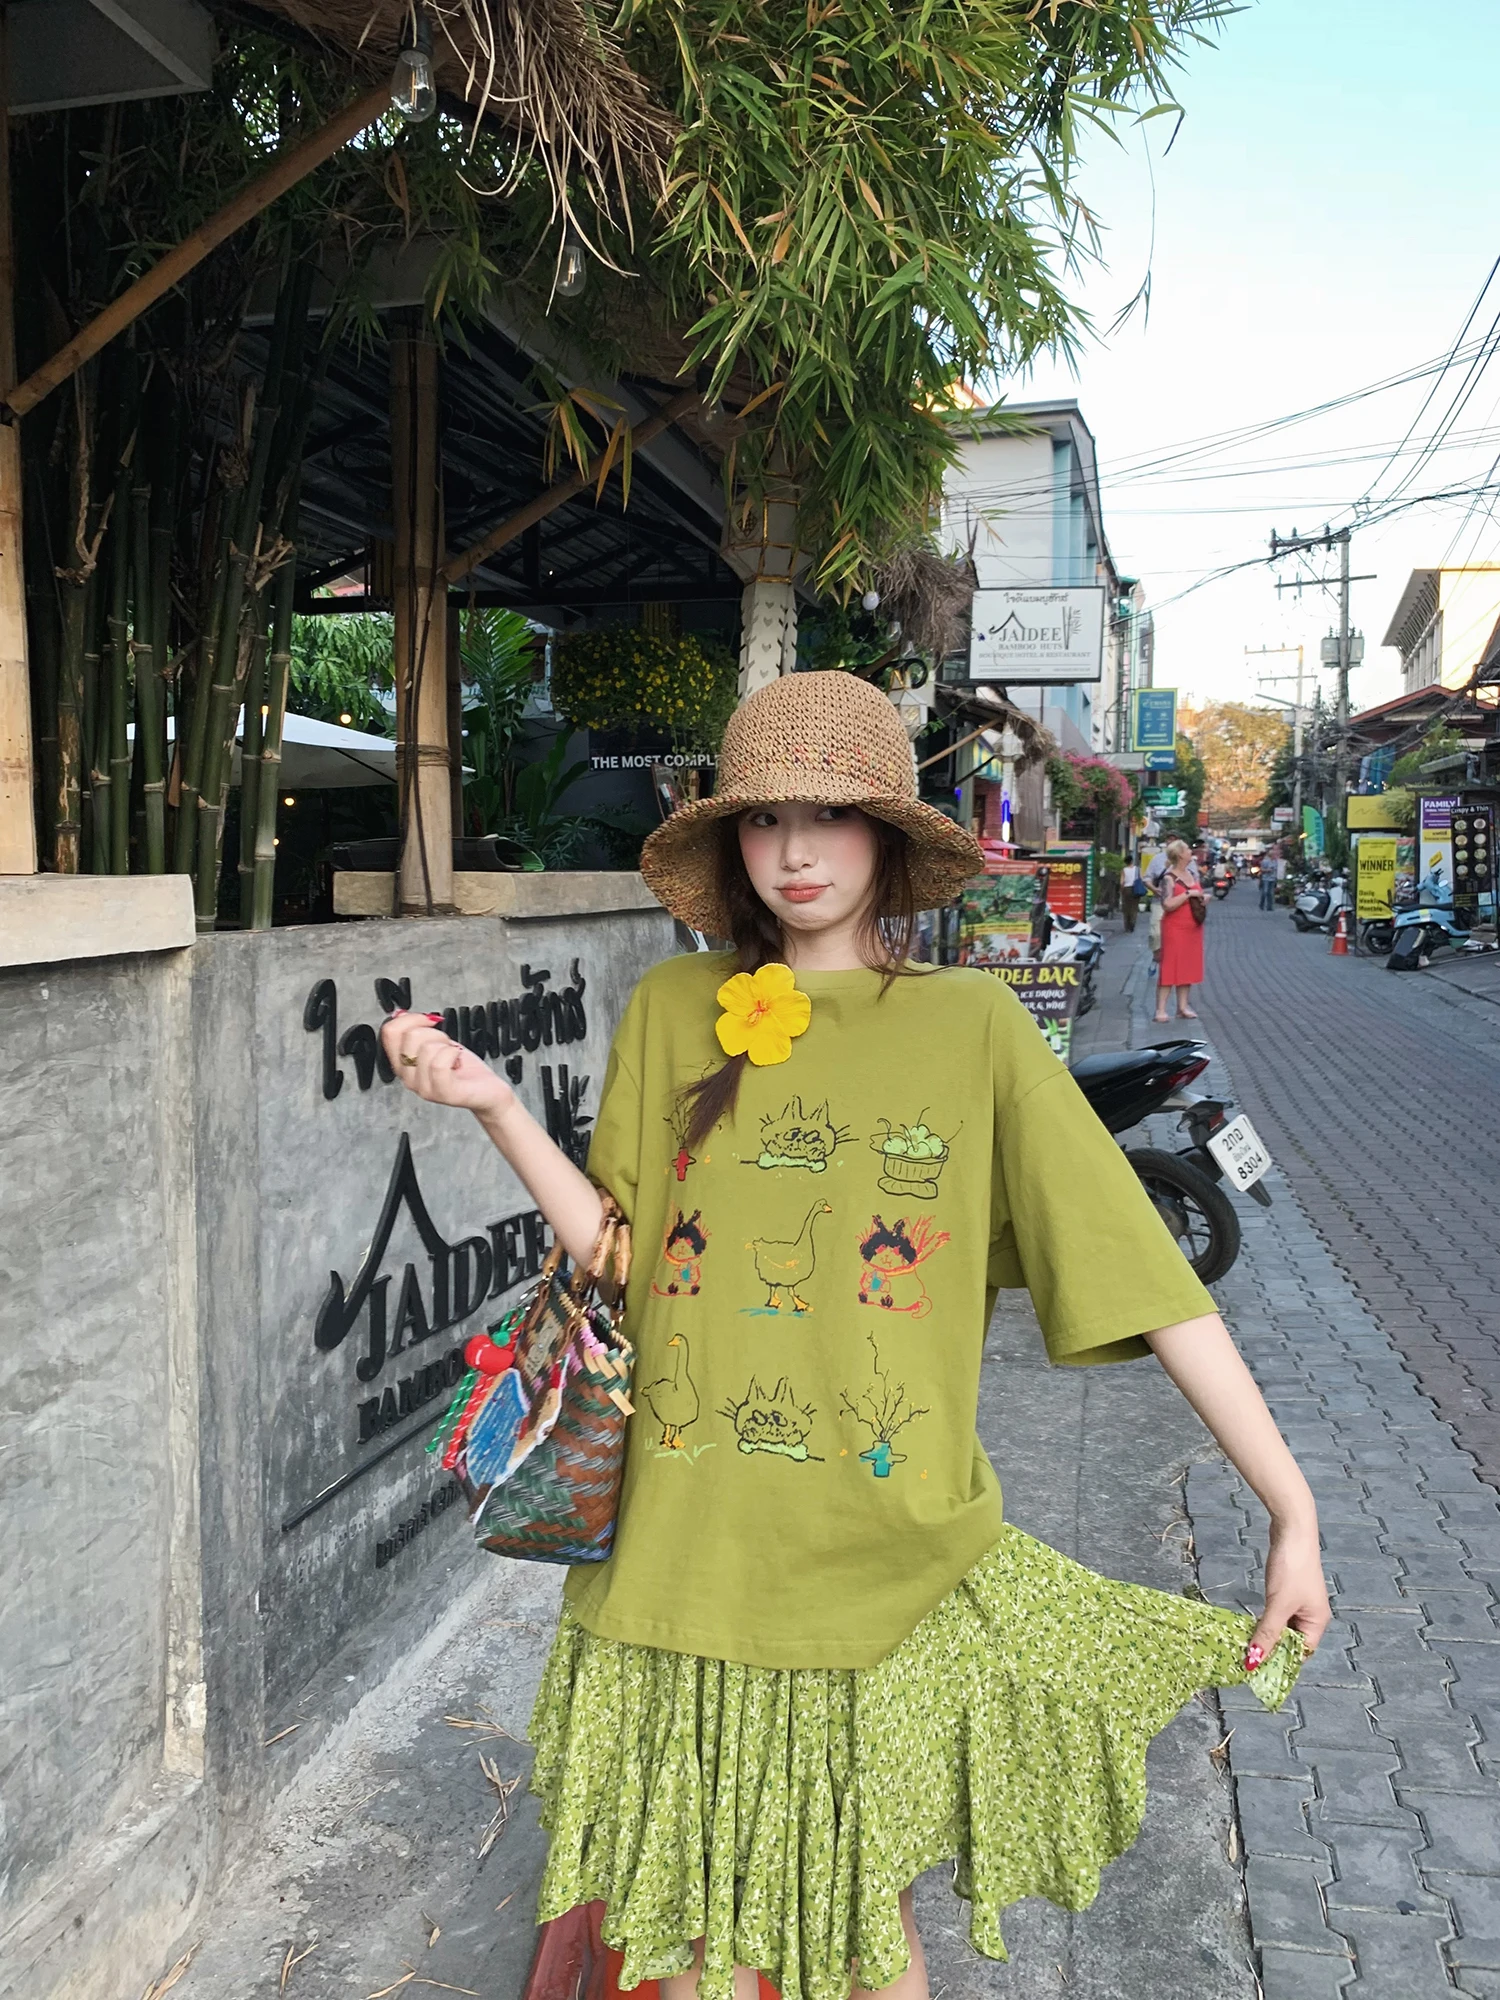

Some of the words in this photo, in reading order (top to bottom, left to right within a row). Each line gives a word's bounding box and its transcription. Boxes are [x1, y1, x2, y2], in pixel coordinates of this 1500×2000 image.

[998, 627, 1062, 642] JAIDEE
[998, 643, 1037, 651] BAMBOO
[1040, 642, 1063, 650] HUTS
[591, 756, 619, 769] THE
[621, 755, 661, 768] MOST
[1424, 800, 1456, 808] FAMILY
[1359, 860, 1394, 871] WINNER
[1037, 966, 1080, 987] BAR
[1020, 990, 1034, 999] ICE
[1035, 989, 1066, 999] DRINKS
[1237, 1151, 1263, 1180] 8304
[356, 1209, 552, 1382] JAIDEE
[357, 1347, 466, 1445] BAMBO
